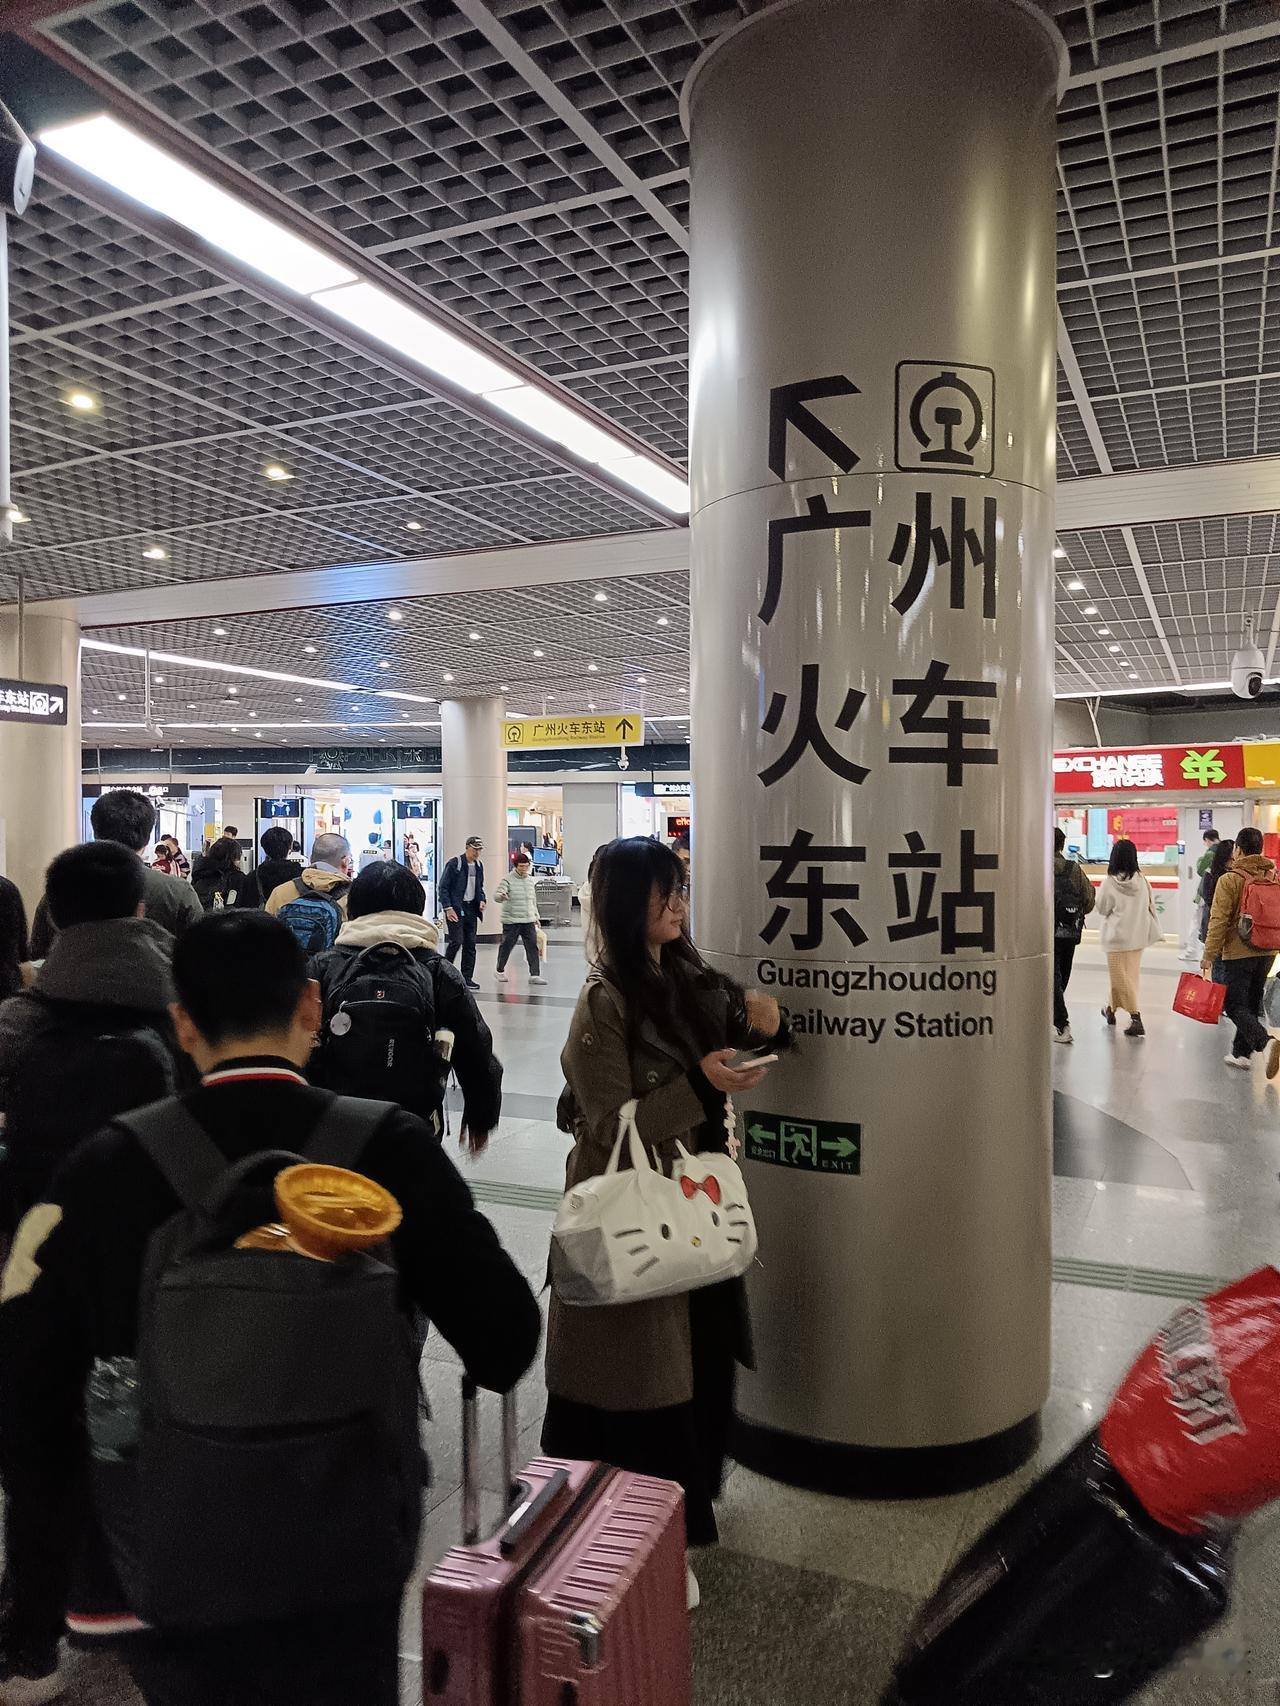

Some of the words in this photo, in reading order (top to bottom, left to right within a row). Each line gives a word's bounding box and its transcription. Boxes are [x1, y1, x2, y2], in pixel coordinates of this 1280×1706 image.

[757, 491, 997, 626] 广州
[533, 720, 606, 736] 广州火车东站
[757, 659, 998, 787] 火车
[757, 828, 999, 955] 东站
[756, 959, 998, 997] Guangzhoudong
[893, 1010, 994, 1039] Station
[821, 1159, 854, 1170] EXIT
